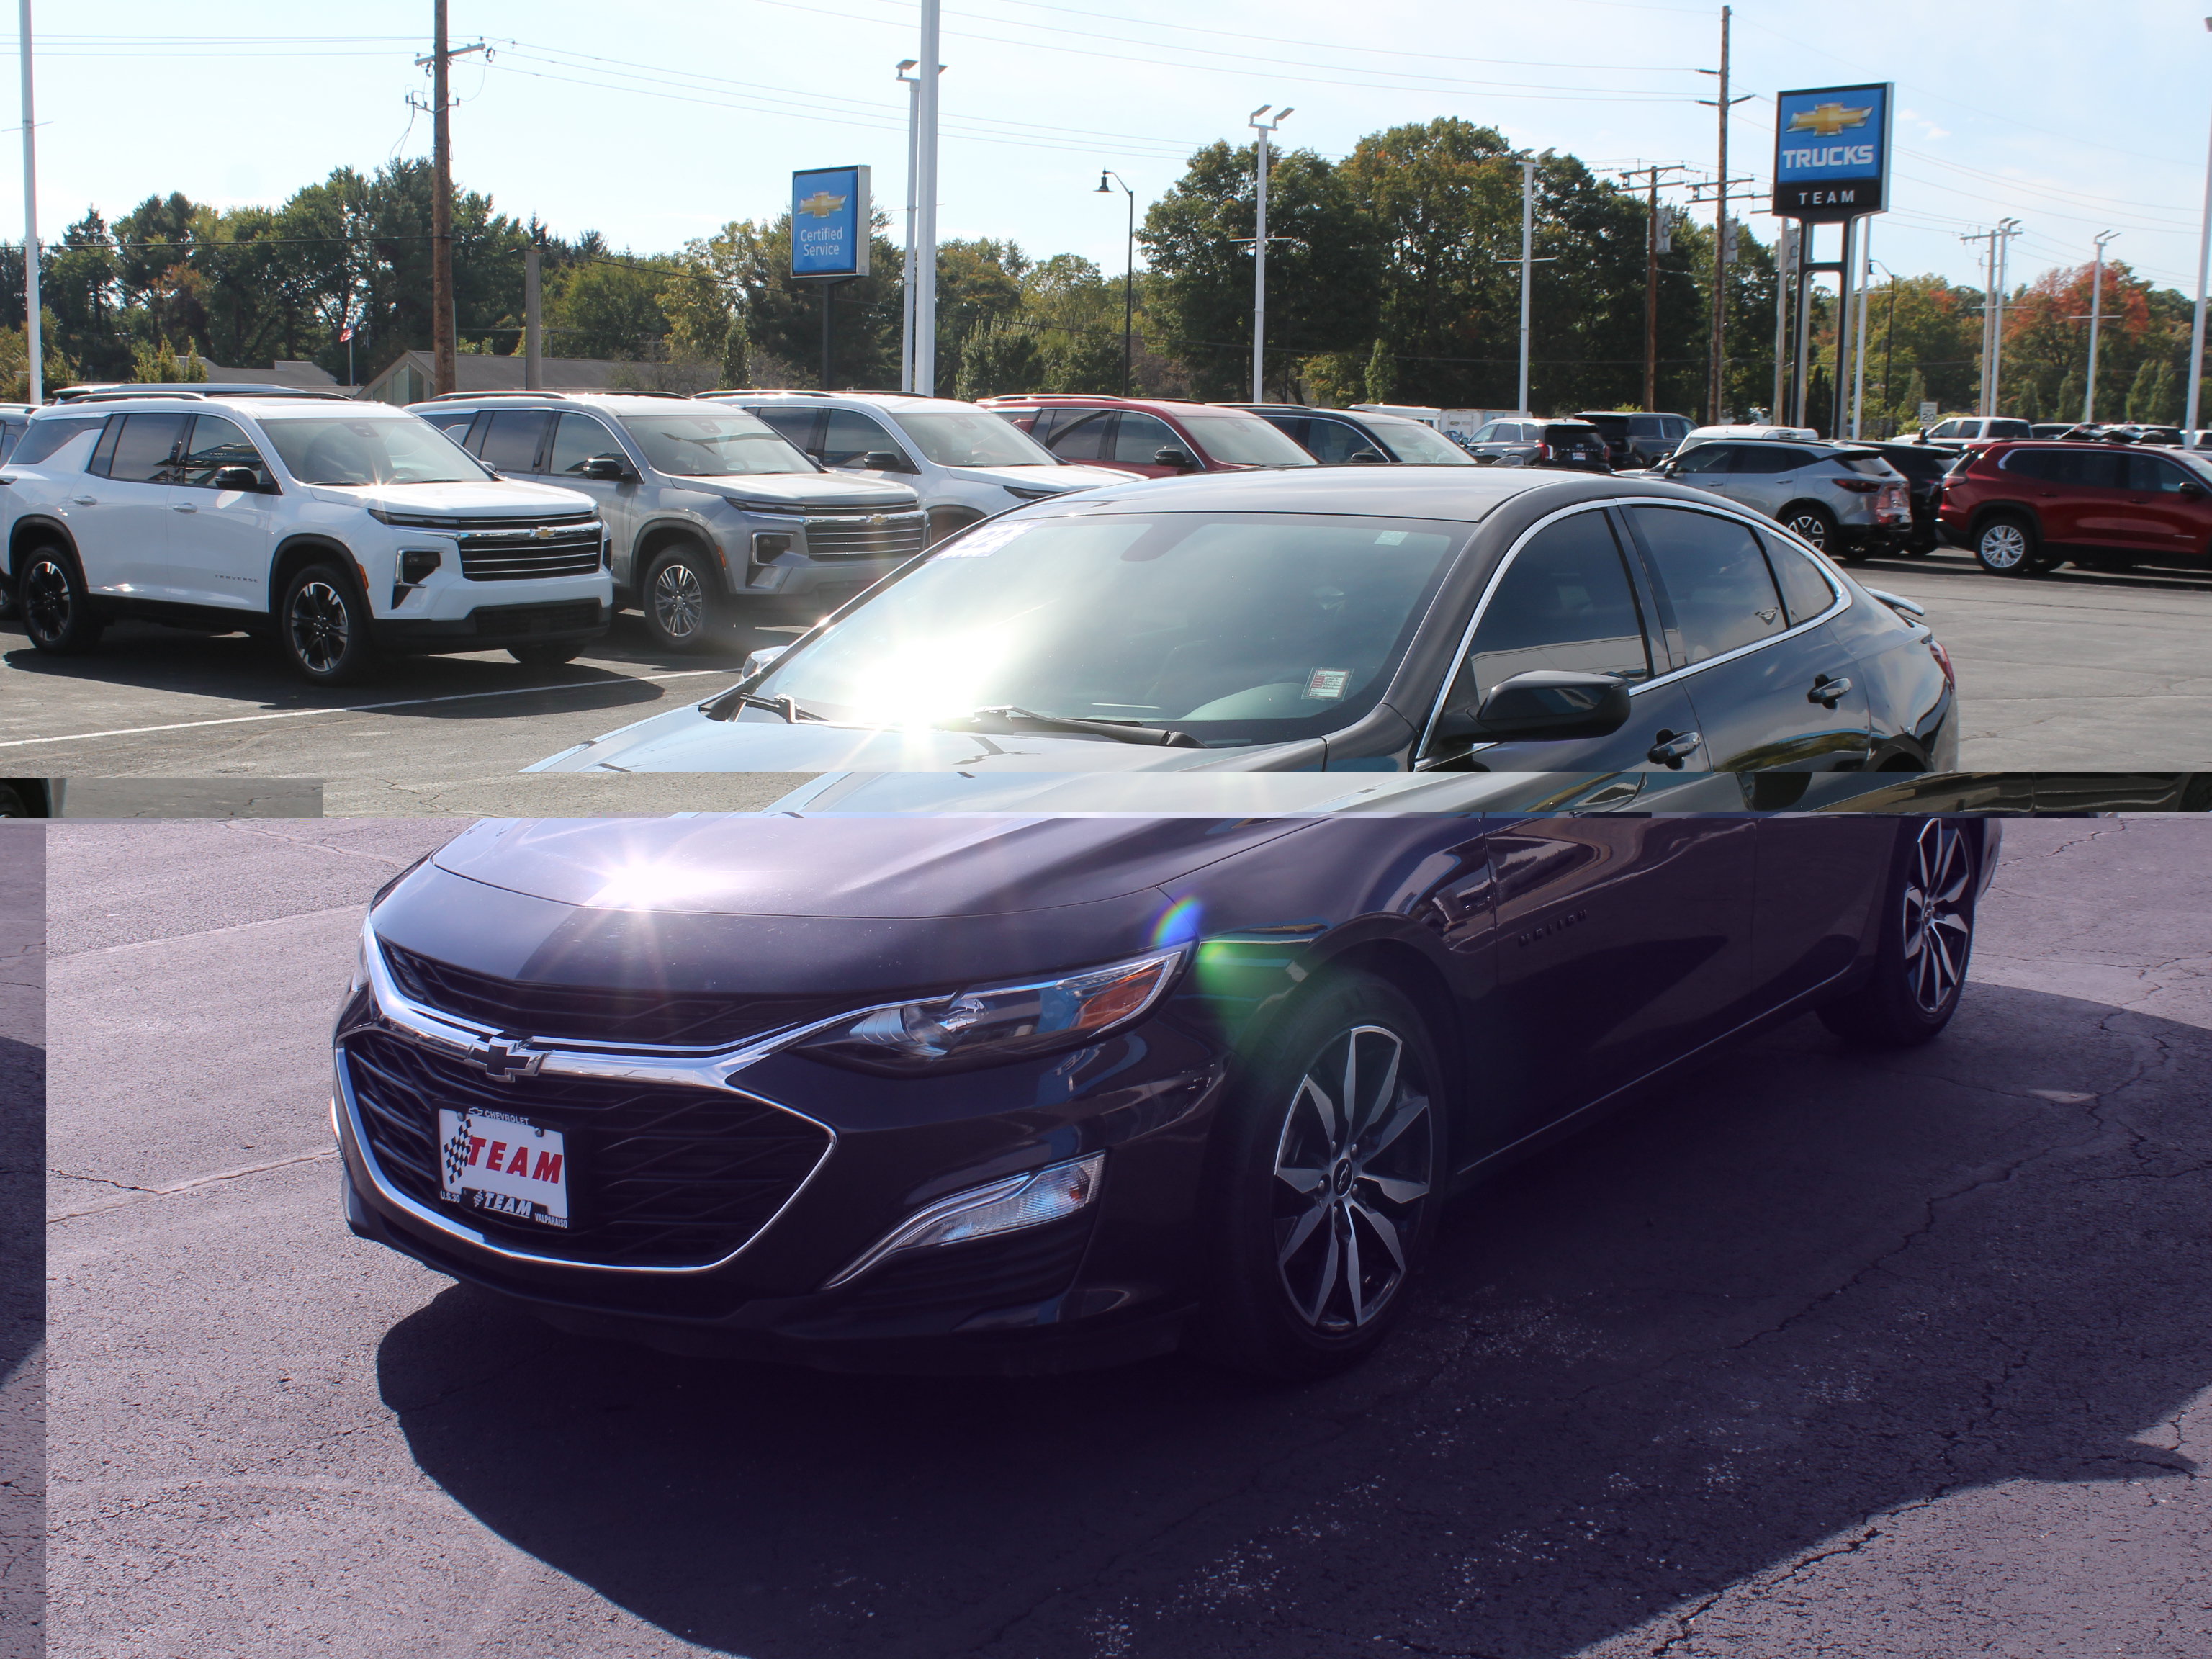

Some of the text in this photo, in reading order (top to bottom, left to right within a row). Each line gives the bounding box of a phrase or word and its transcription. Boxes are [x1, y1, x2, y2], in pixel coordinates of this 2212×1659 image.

[1782, 145, 1874, 168] TRUCKS
[1799, 190, 1855, 204] TEAM
[801, 227, 842, 242] Certified
[804, 243, 840, 256] Service
[1922, 413, 1935, 422] 20
[956, 529, 1015, 550] 22
[485, 1110, 529, 1125] CHEVROLET
[467, 1136, 563, 1184] TEAM
[484, 1192, 532, 1217] TEAM
[534, 1213, 568, 1228] VALPARAISO
